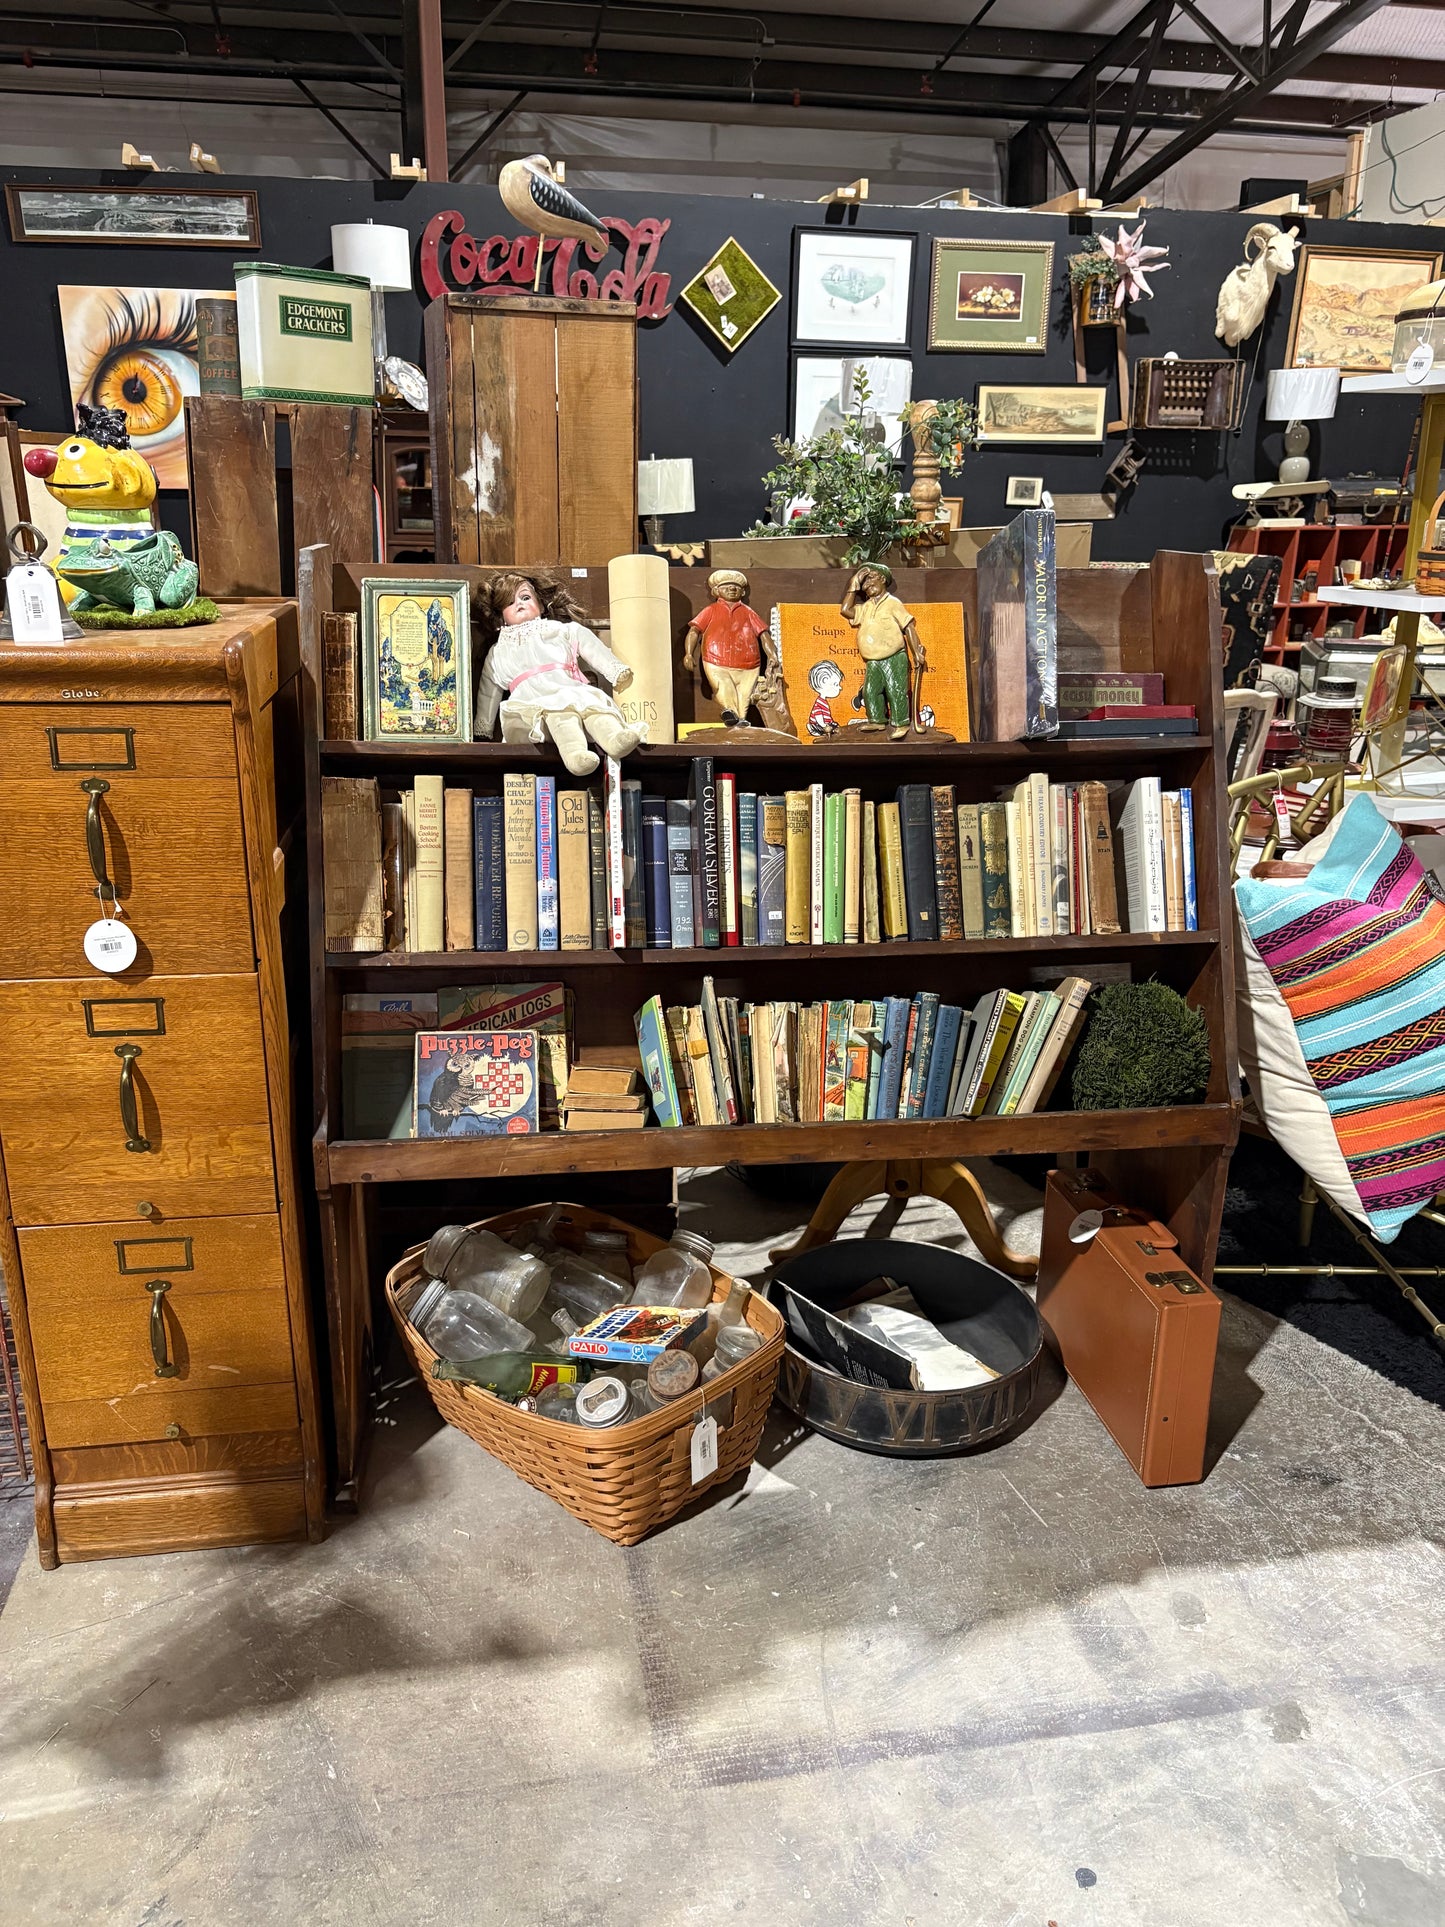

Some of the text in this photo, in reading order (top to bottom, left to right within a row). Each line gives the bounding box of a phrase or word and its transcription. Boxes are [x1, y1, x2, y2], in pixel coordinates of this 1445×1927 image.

[286, 301, 345, 321] EDGEMONT
[287, 315, 346, 335] CRACKERS
[201, 366, 238, 380] COFFEE
[1034, 560, 1049, 679] VALOR IN ACTION
[812, 625, 846, 636] Snaps
[828, 643, 860, 656] Scrap
[853, 667, 866, 675] an
[705, 760, 713, 782] Carpenter
[512, 806, 524, 816] An
[561, 797, 583, 811] Old
[562, 811, 584, 827] Jules
[417, 830, 440, 838] Cooking
[508, 833, 532, 842] Nevada
[702, 785, 719, 908] GORHAM SILVER
[718, 817, 732, 874] CHRISTIE'S
[490, 811, 502, 939] WEDEMEYER REPORTS!
[521, 994, 552, 1018] LOGS
[1024, 998, 1041, 1029] CHAMPION
[922, 1023, 931, 1047] SECRET
[942, 1031, 952, 1045] The
[1018, 1029, 1028, 1042] DOG
[420, 1034, 533, 1059] Puzzle-Peg
[1010, 1043, 1021, 1062] PRINCE
[885, 1007, 903, 1109] UNCLE WIGGILY'S ADVENTURES
[1004, 1062, 1013, 1077] TOM
[932, 1085, 941, 1107] Books
[460, 1129, 485, 1137] SOLVE
[616, 1309, 640, 1327] BALLS
[658, 1325, 683, 1342] PATIO
[573, 1342, 607, 1355] PATIO
